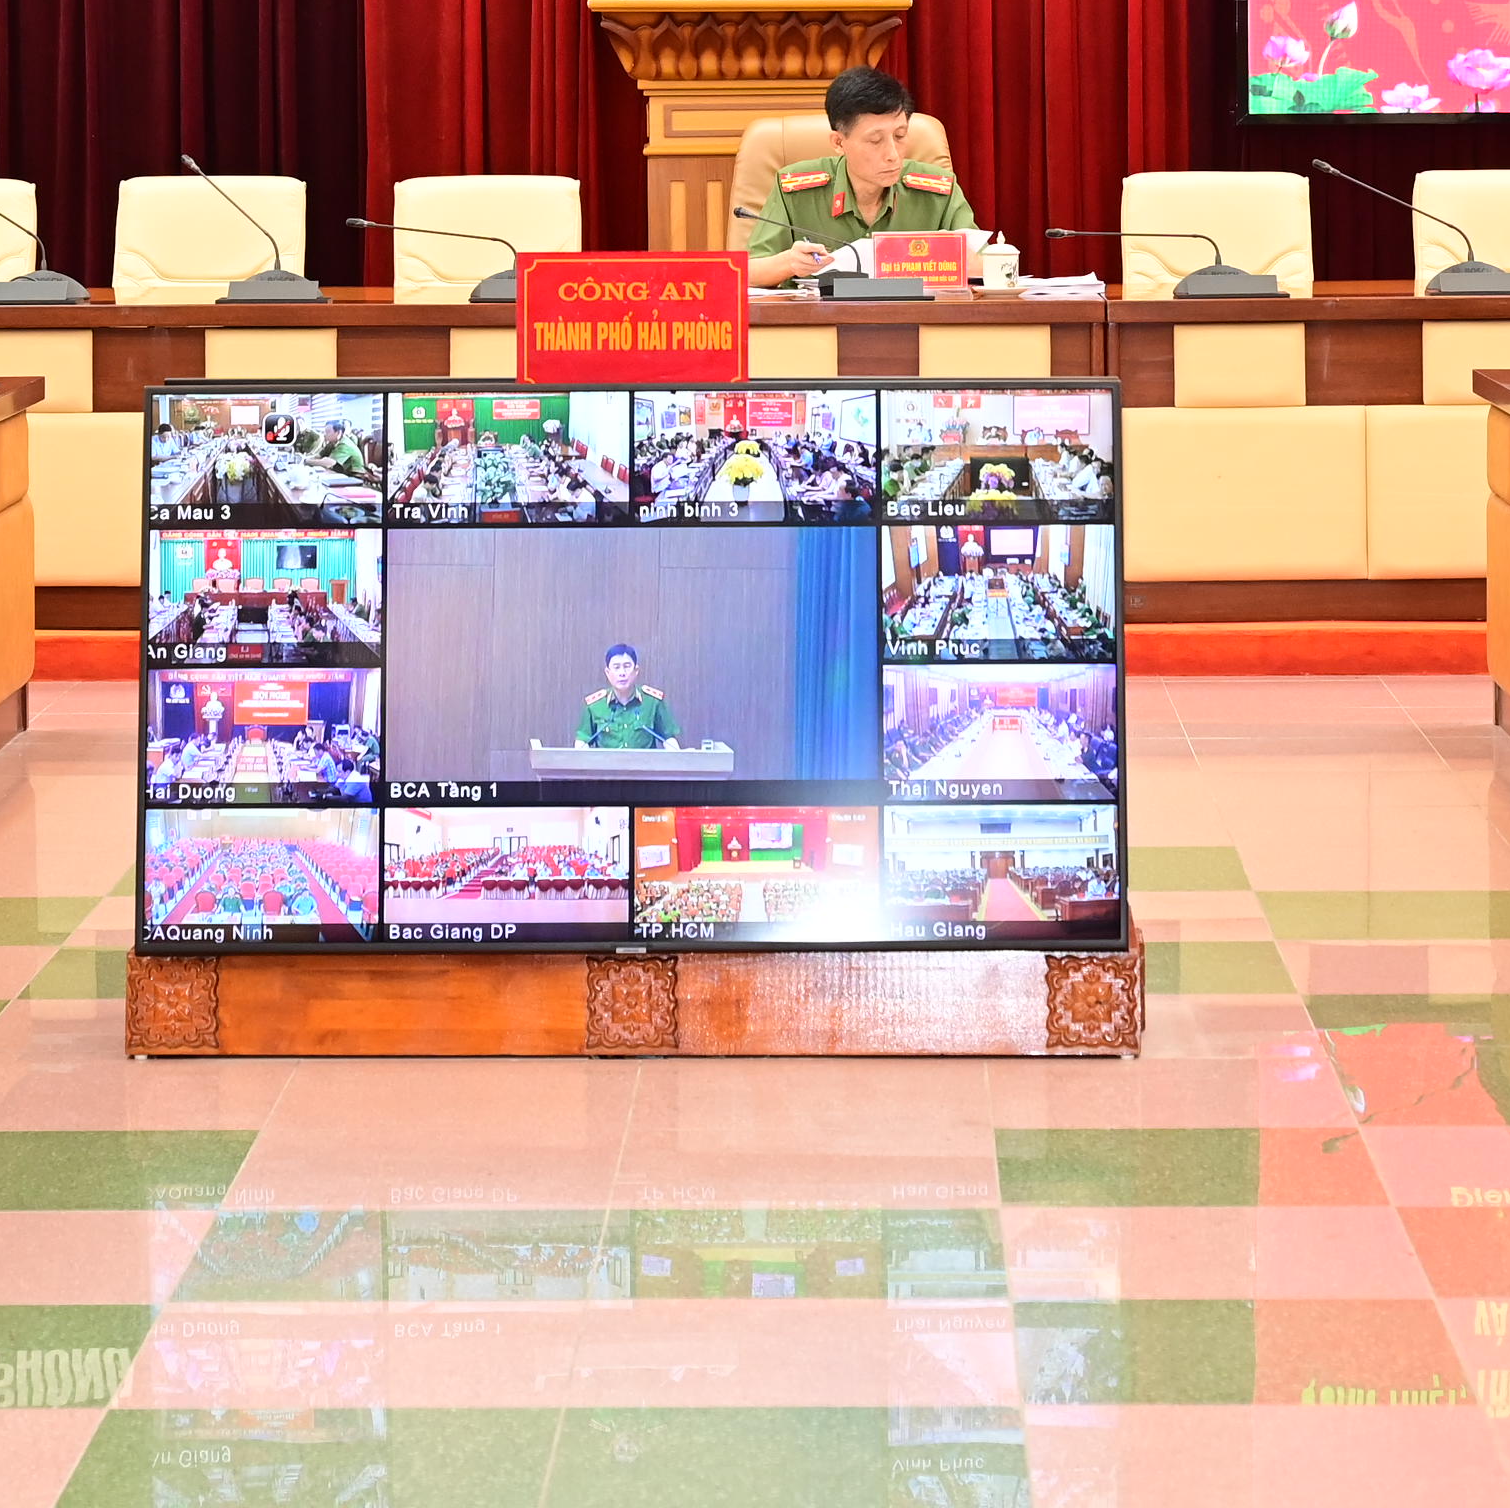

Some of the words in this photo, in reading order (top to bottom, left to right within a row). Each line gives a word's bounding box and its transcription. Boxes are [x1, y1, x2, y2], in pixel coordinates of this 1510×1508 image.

[558, 277, 649, 301] CÔNG
[659, 282, 706, 300] AN
[534, 316, 591, 350] THÀNH
[597, 312, 632, 350] PHỐ
[638, 309, 666, 350] HẢI
[673, 314, 732, 350] PHÒNG
[150, 505, 170, 520] Ca
[177, 504, 214, 520] Mau
[220, 504, 231, 520] 3
[392, 505, 422, 520] Tra
[427, 504, 468, 519] Vinh
[639, 502, 676, 518] ninh
[684, 501, 723, 518] binh
[728, 501, 739, 517] 3
[886, 501, 921, 517] Bac
[927, 501, 965, 516] Lieu
[174, 643, 227, 663] Giang
[887, 640, 928, 655] Vinh
[934, 640, 980, 655] Phuc
[178, 784, 236, 803] Duong
[390, 783, 430, 798] BCA
[436, 780, 482, 802] Tầng
[489, 783, 497, 798] 1
[889, 780, 928, 796] Thai
[935, 780, 1003, 798] Nguyen
[233, 925, 273, 940] Ninh
[389, 925, 423, 940] Bac
[429, 924, 484, 943] Giang
[490, 924, 517, 939] DP
[639, 923, 715, 939] TP.HCM
[934, 922, 986, 940] Giang
